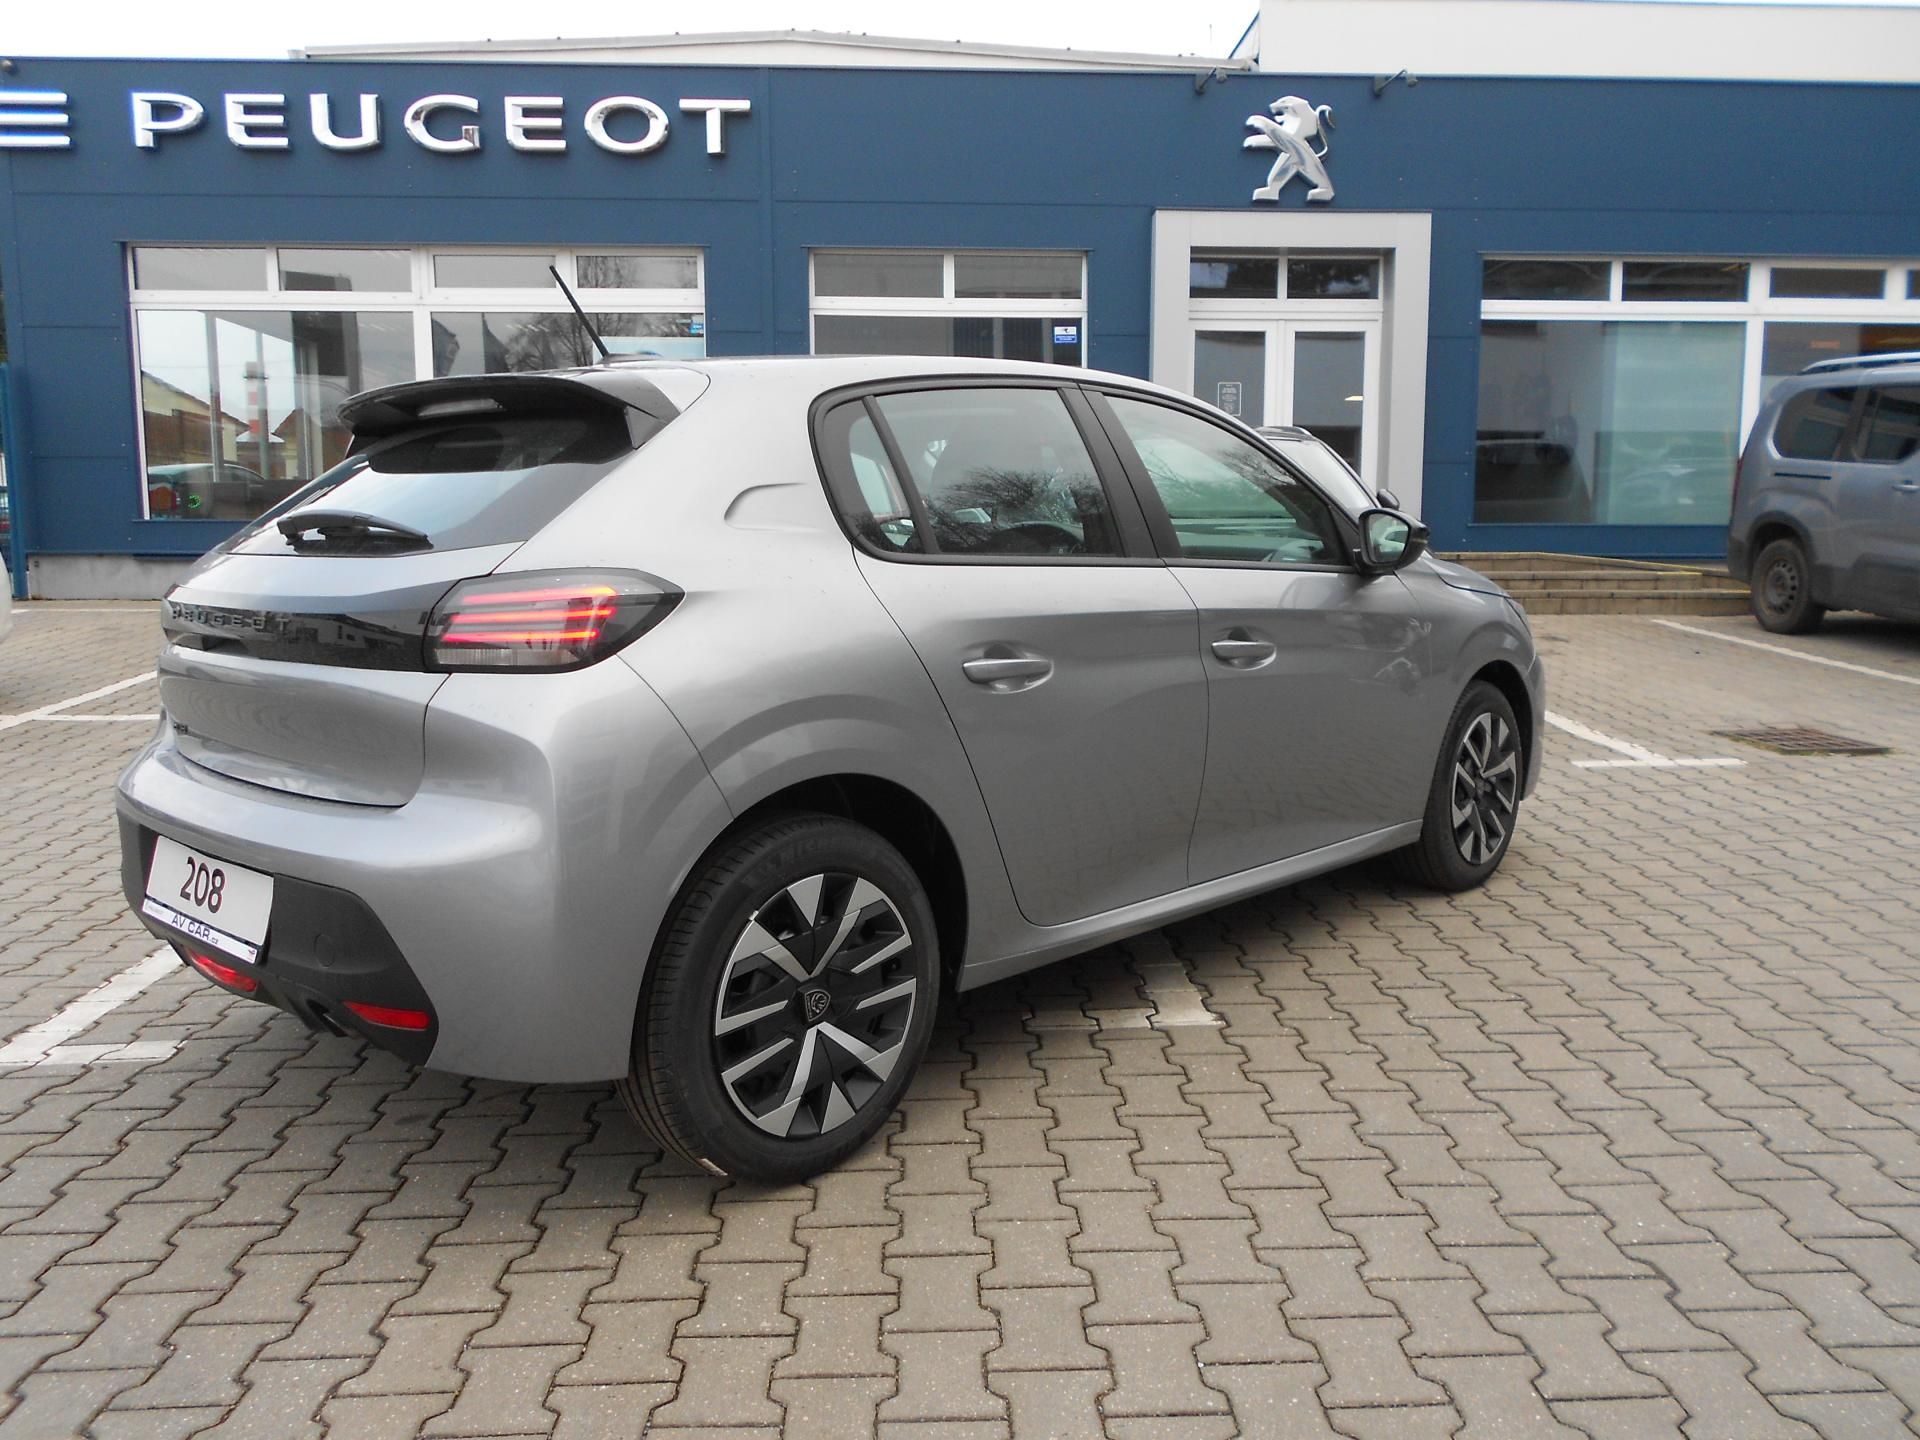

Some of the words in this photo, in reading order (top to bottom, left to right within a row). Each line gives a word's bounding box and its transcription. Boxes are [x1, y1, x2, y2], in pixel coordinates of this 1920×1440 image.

[131, 91, 752, 156] PEUGEOT
[179, 856, 226, 914] 208
[171, 913, 186, 929] AV
